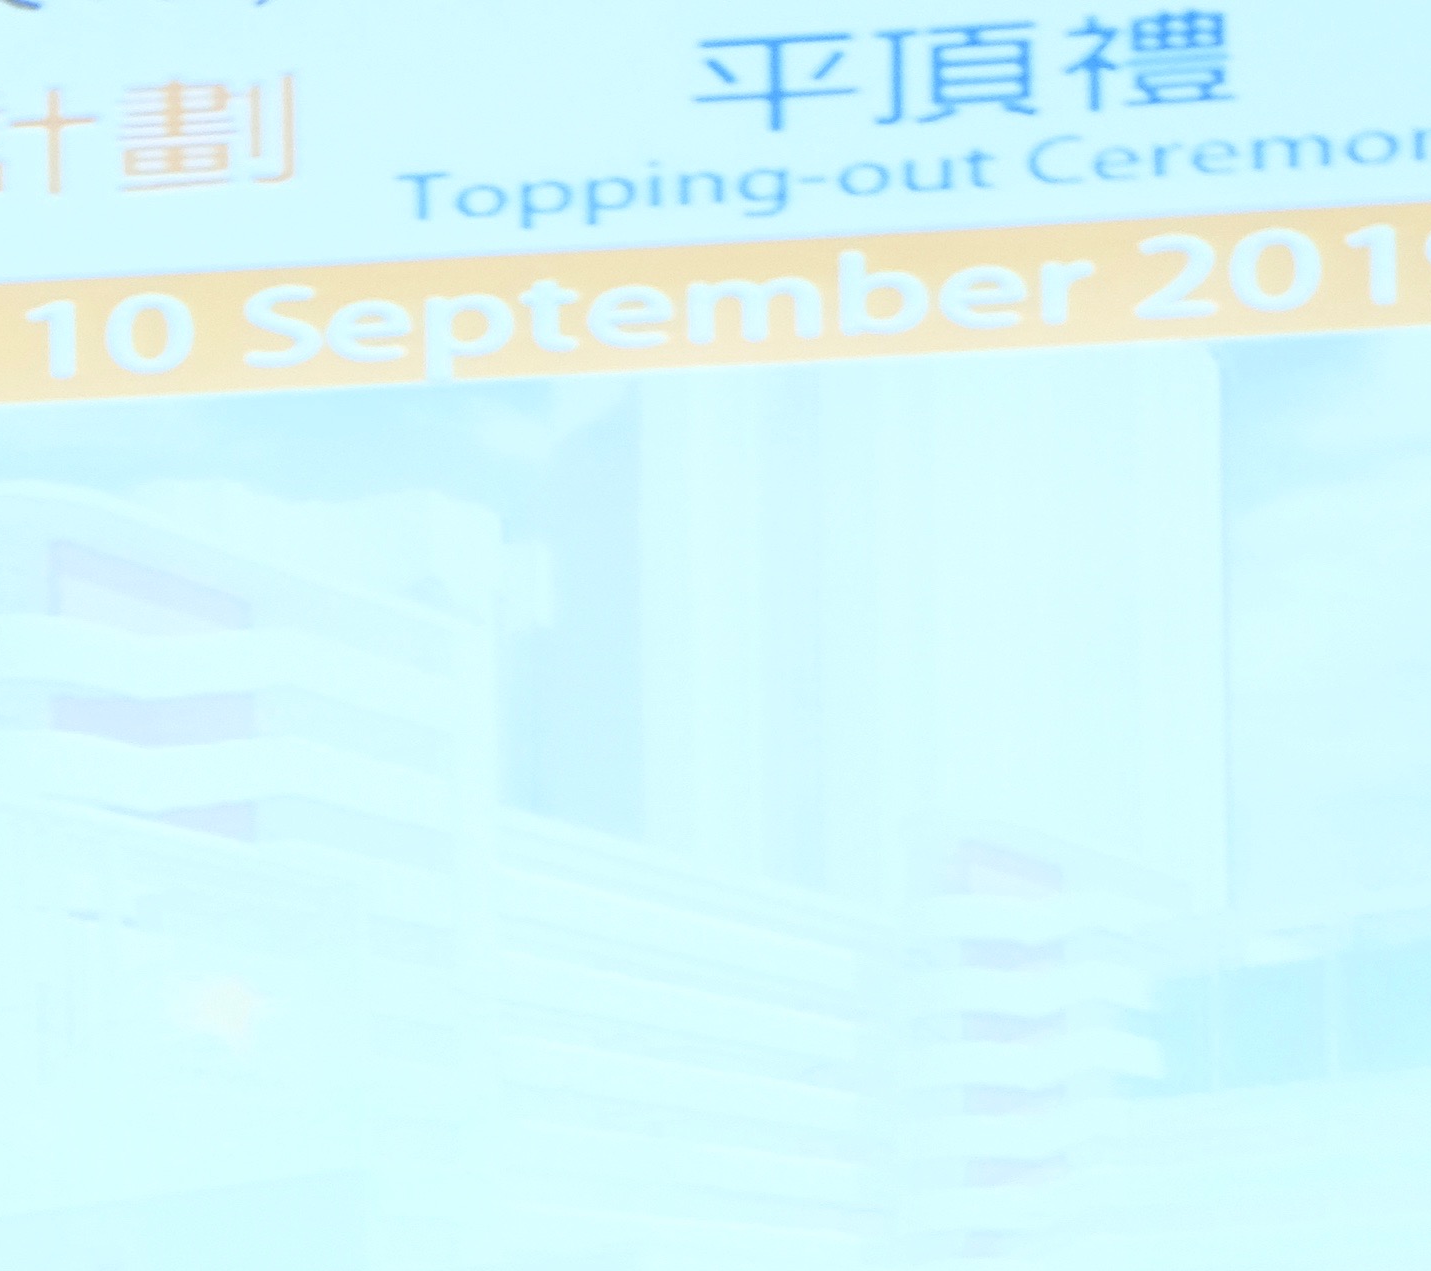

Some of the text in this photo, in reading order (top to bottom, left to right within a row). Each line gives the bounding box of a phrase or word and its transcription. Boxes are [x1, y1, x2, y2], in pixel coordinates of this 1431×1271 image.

[689, 5, 1240, 132] 平頂禮
[395, 146, 996, 230] Topping-out
[26, 290, 197, 379] 10
[242, 249, 1096, 382] September
